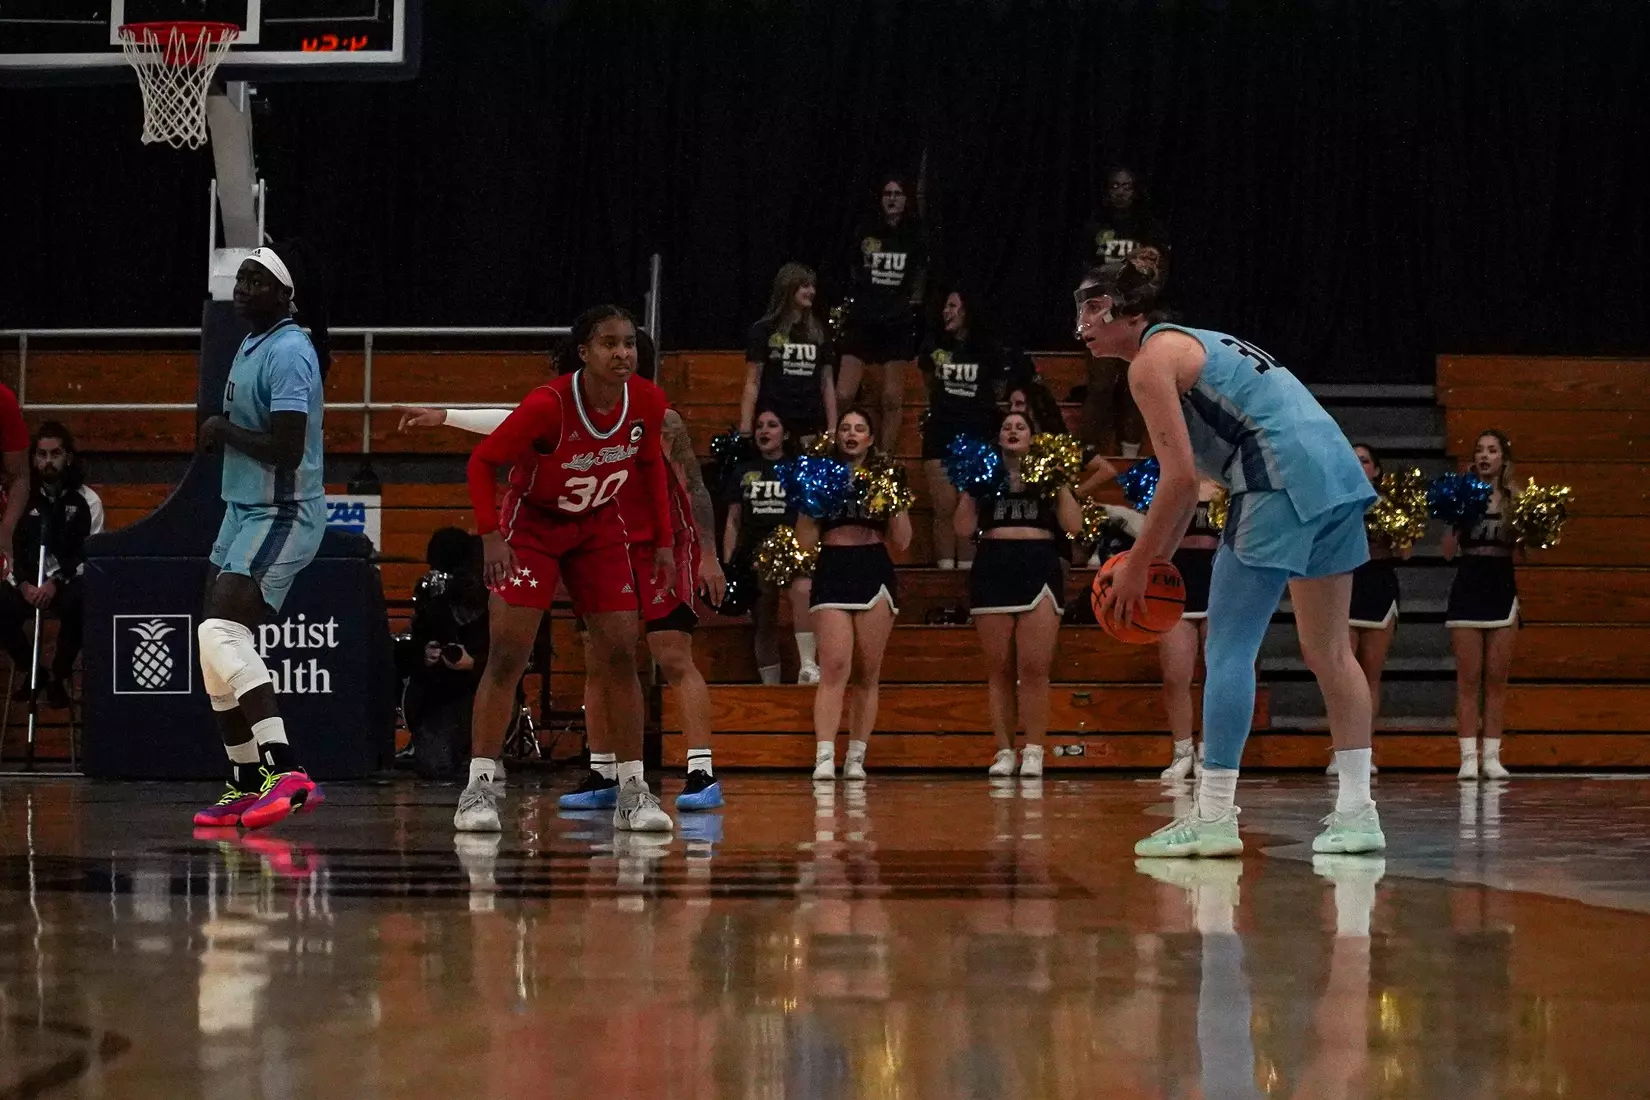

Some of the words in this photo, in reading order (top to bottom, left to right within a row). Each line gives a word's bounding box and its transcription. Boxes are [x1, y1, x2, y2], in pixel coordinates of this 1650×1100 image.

[871, 252, 908, 271] FIU
[782, 343, 817, 361] FIU
[1220, 338, 1282, 375] 3
[943, 363, 979, 382] FIU
[558, 469, 629, 512] 30
[750, 480, 787, 499] FIU
[253, 613, 340, 659] ptist
[268, 658, 333, 694] alth
